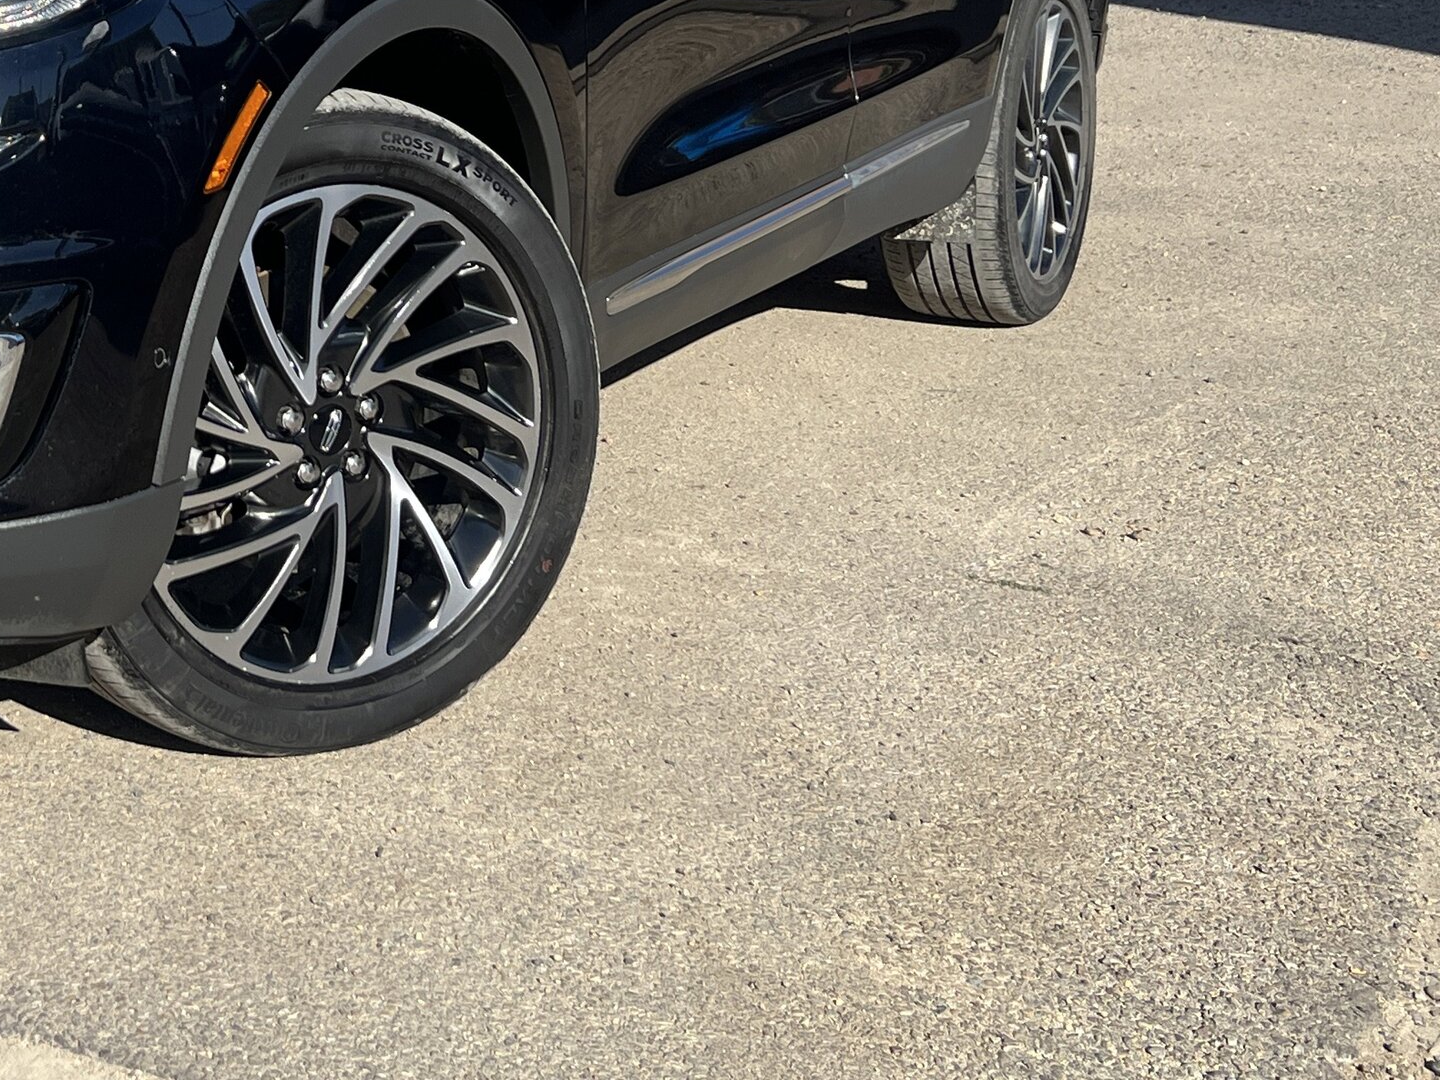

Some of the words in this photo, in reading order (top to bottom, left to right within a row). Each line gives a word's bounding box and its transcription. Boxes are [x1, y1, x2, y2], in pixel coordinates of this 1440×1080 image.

[380, 131, 434, 153] CROSS
[380, 144, 433, 161] CONTACT
[435, 146, 471, 179] LX
[473, 167, 519, 207] SPORT
